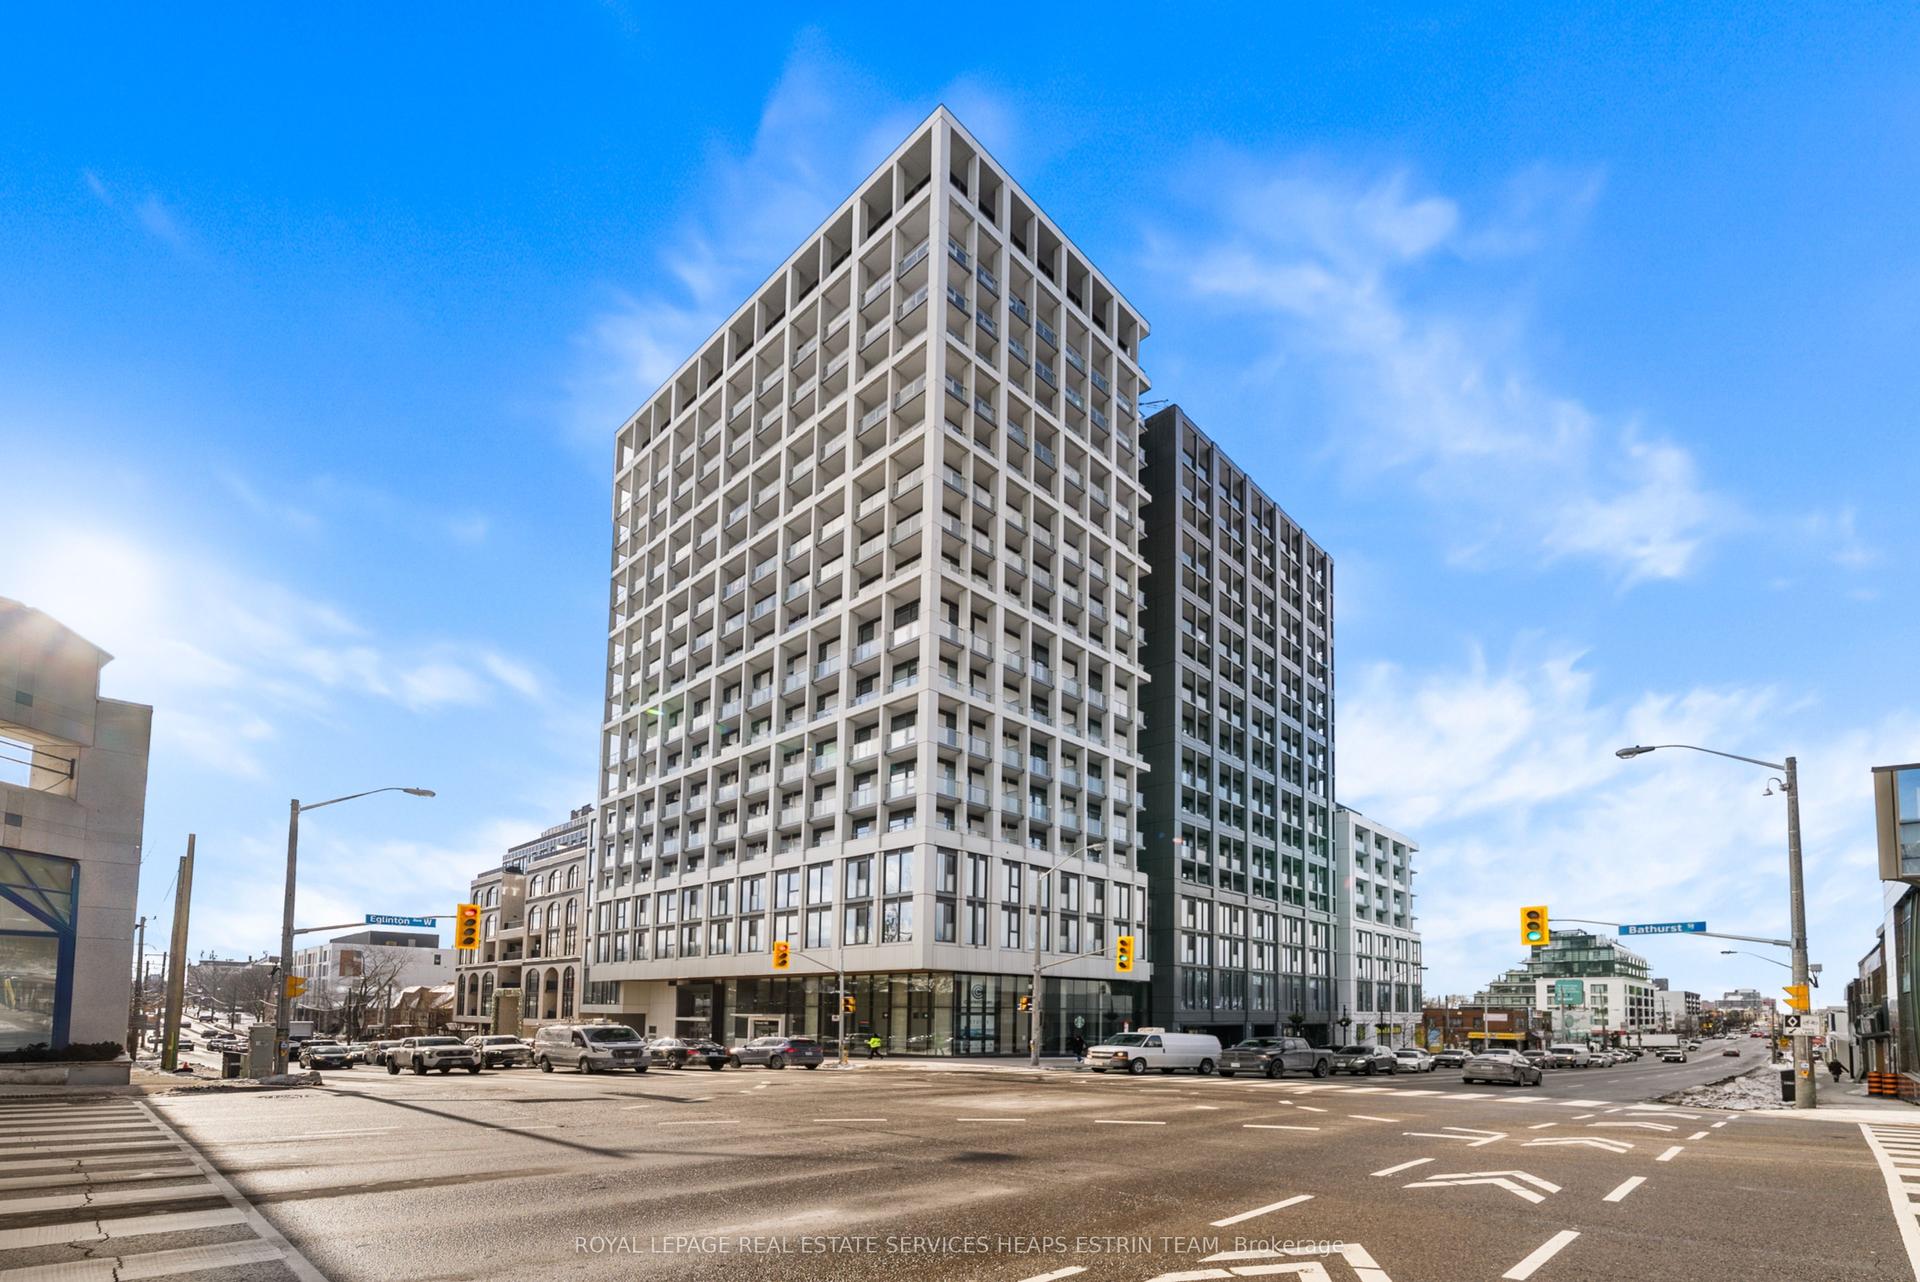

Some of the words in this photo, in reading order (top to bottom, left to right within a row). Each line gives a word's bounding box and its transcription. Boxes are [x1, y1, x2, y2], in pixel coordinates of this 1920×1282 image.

[370, 915, 410, 925] Eglinton
[423, 918, 432, 926] W
[1628, 924, 1682, 934] Bathurst
